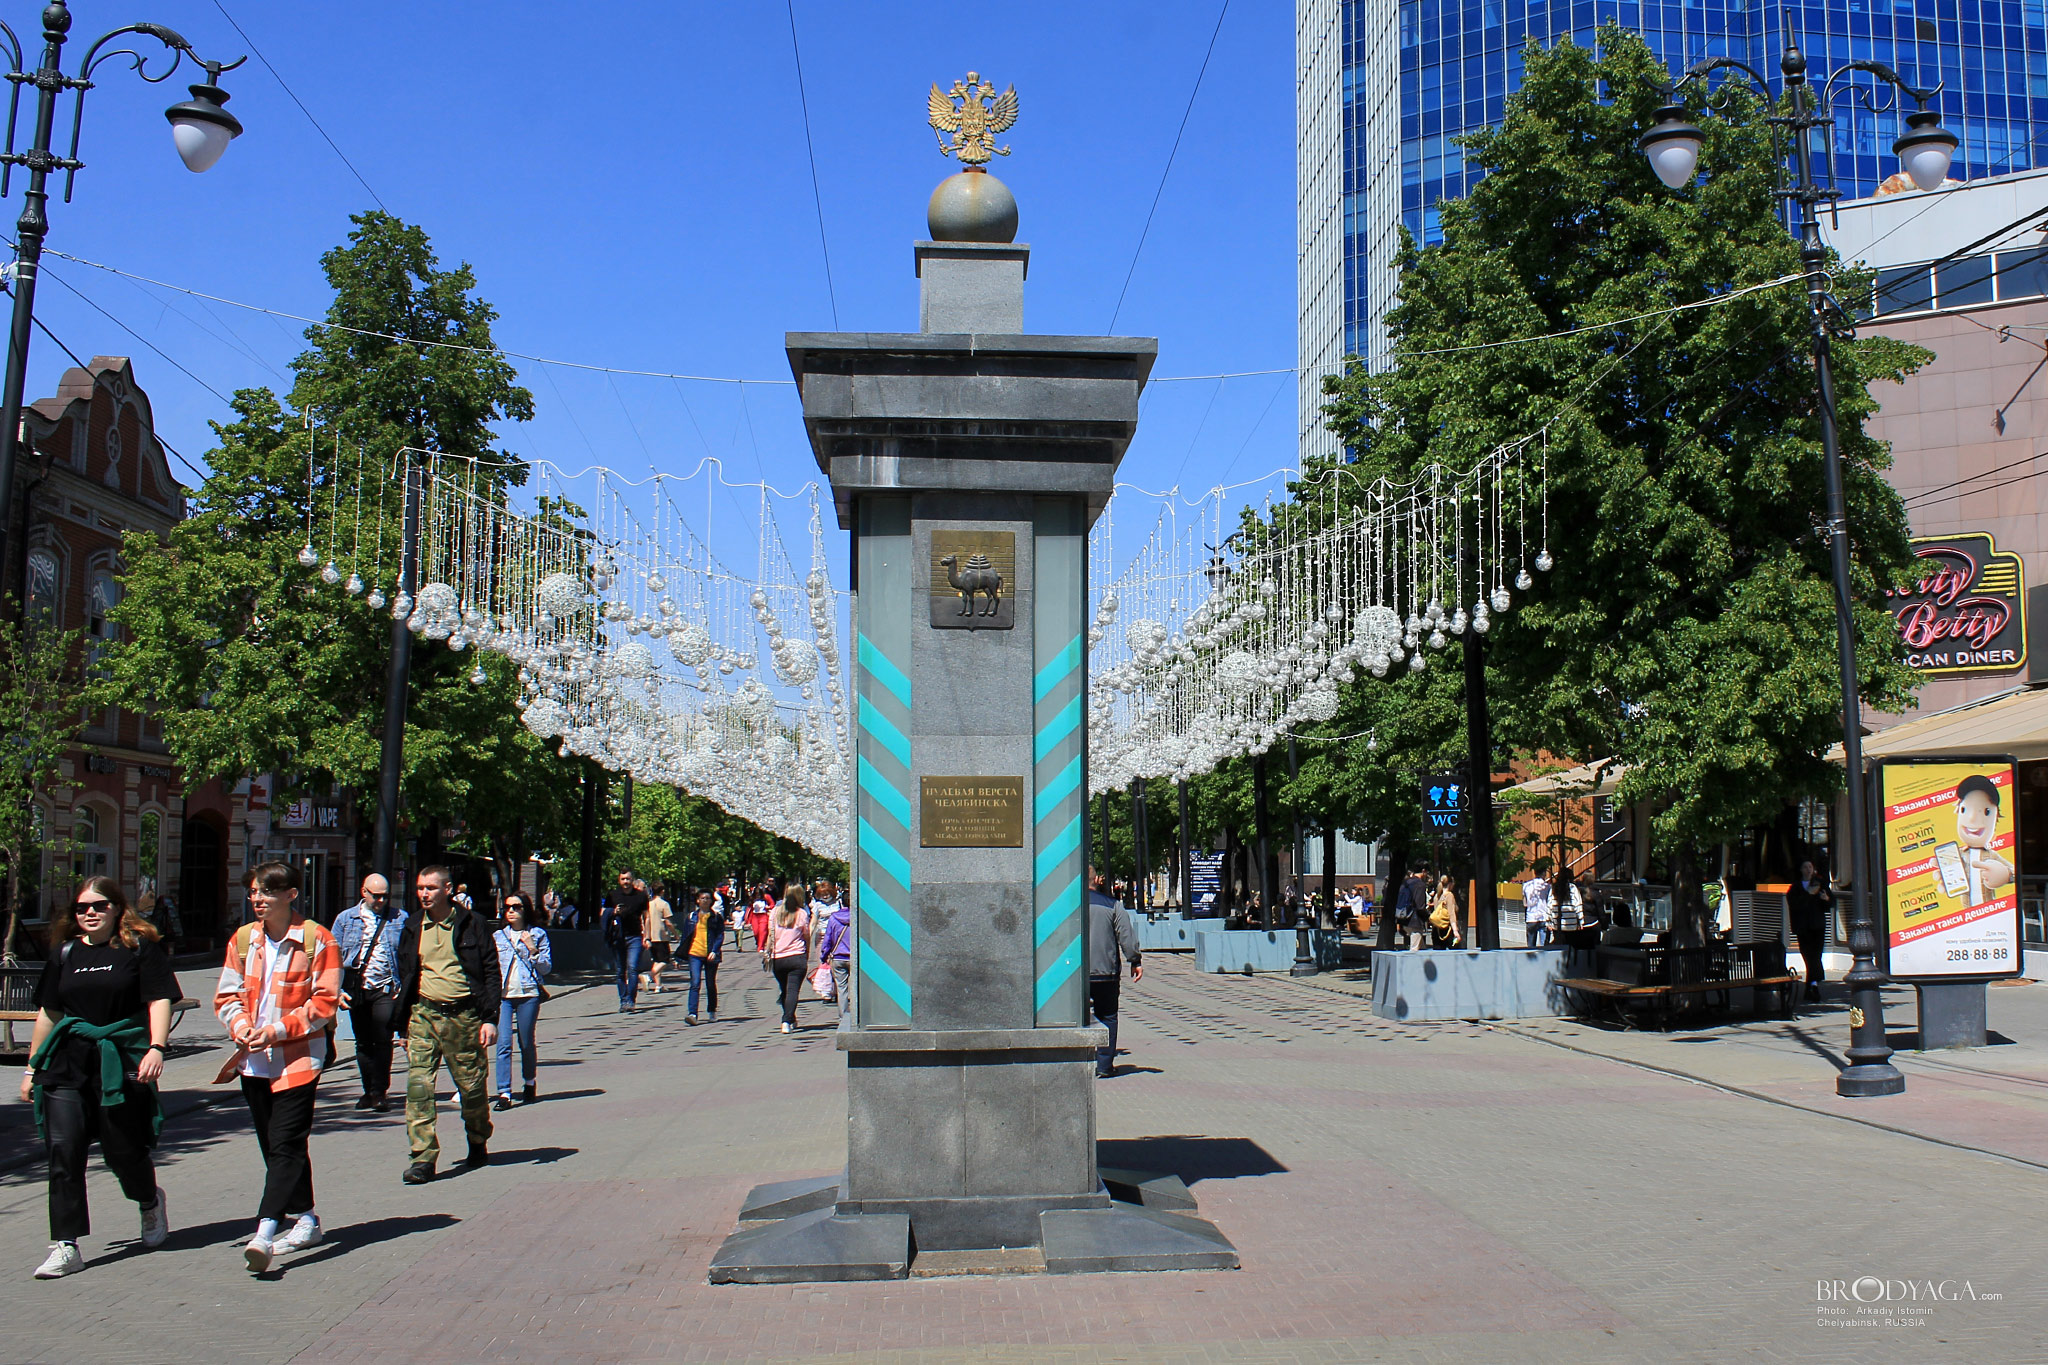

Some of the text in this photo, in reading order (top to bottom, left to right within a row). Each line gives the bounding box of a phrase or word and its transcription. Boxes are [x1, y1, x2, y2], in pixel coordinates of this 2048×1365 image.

[1896, 597, 2012, 649] Betty
[1956, 649, 2016, 665] DINER
[926, 787, 1018, 796] НУЛЕВАЯ ВЕРСТА
[935, 799, 1008, 807] ЧЕЛЯБИНСКА
[1893, 798, 1930, 815] Закажи
[318, 807, 338, 828] VAPE
[1431, 814, 1458, 827] WC
[1897, 827, 1935, 844] maxim
[1900, 892, 1937, 909] maxim
[1899, 924, 1935, 941] Закажи
[1936, 915, 1963, 930] такси
